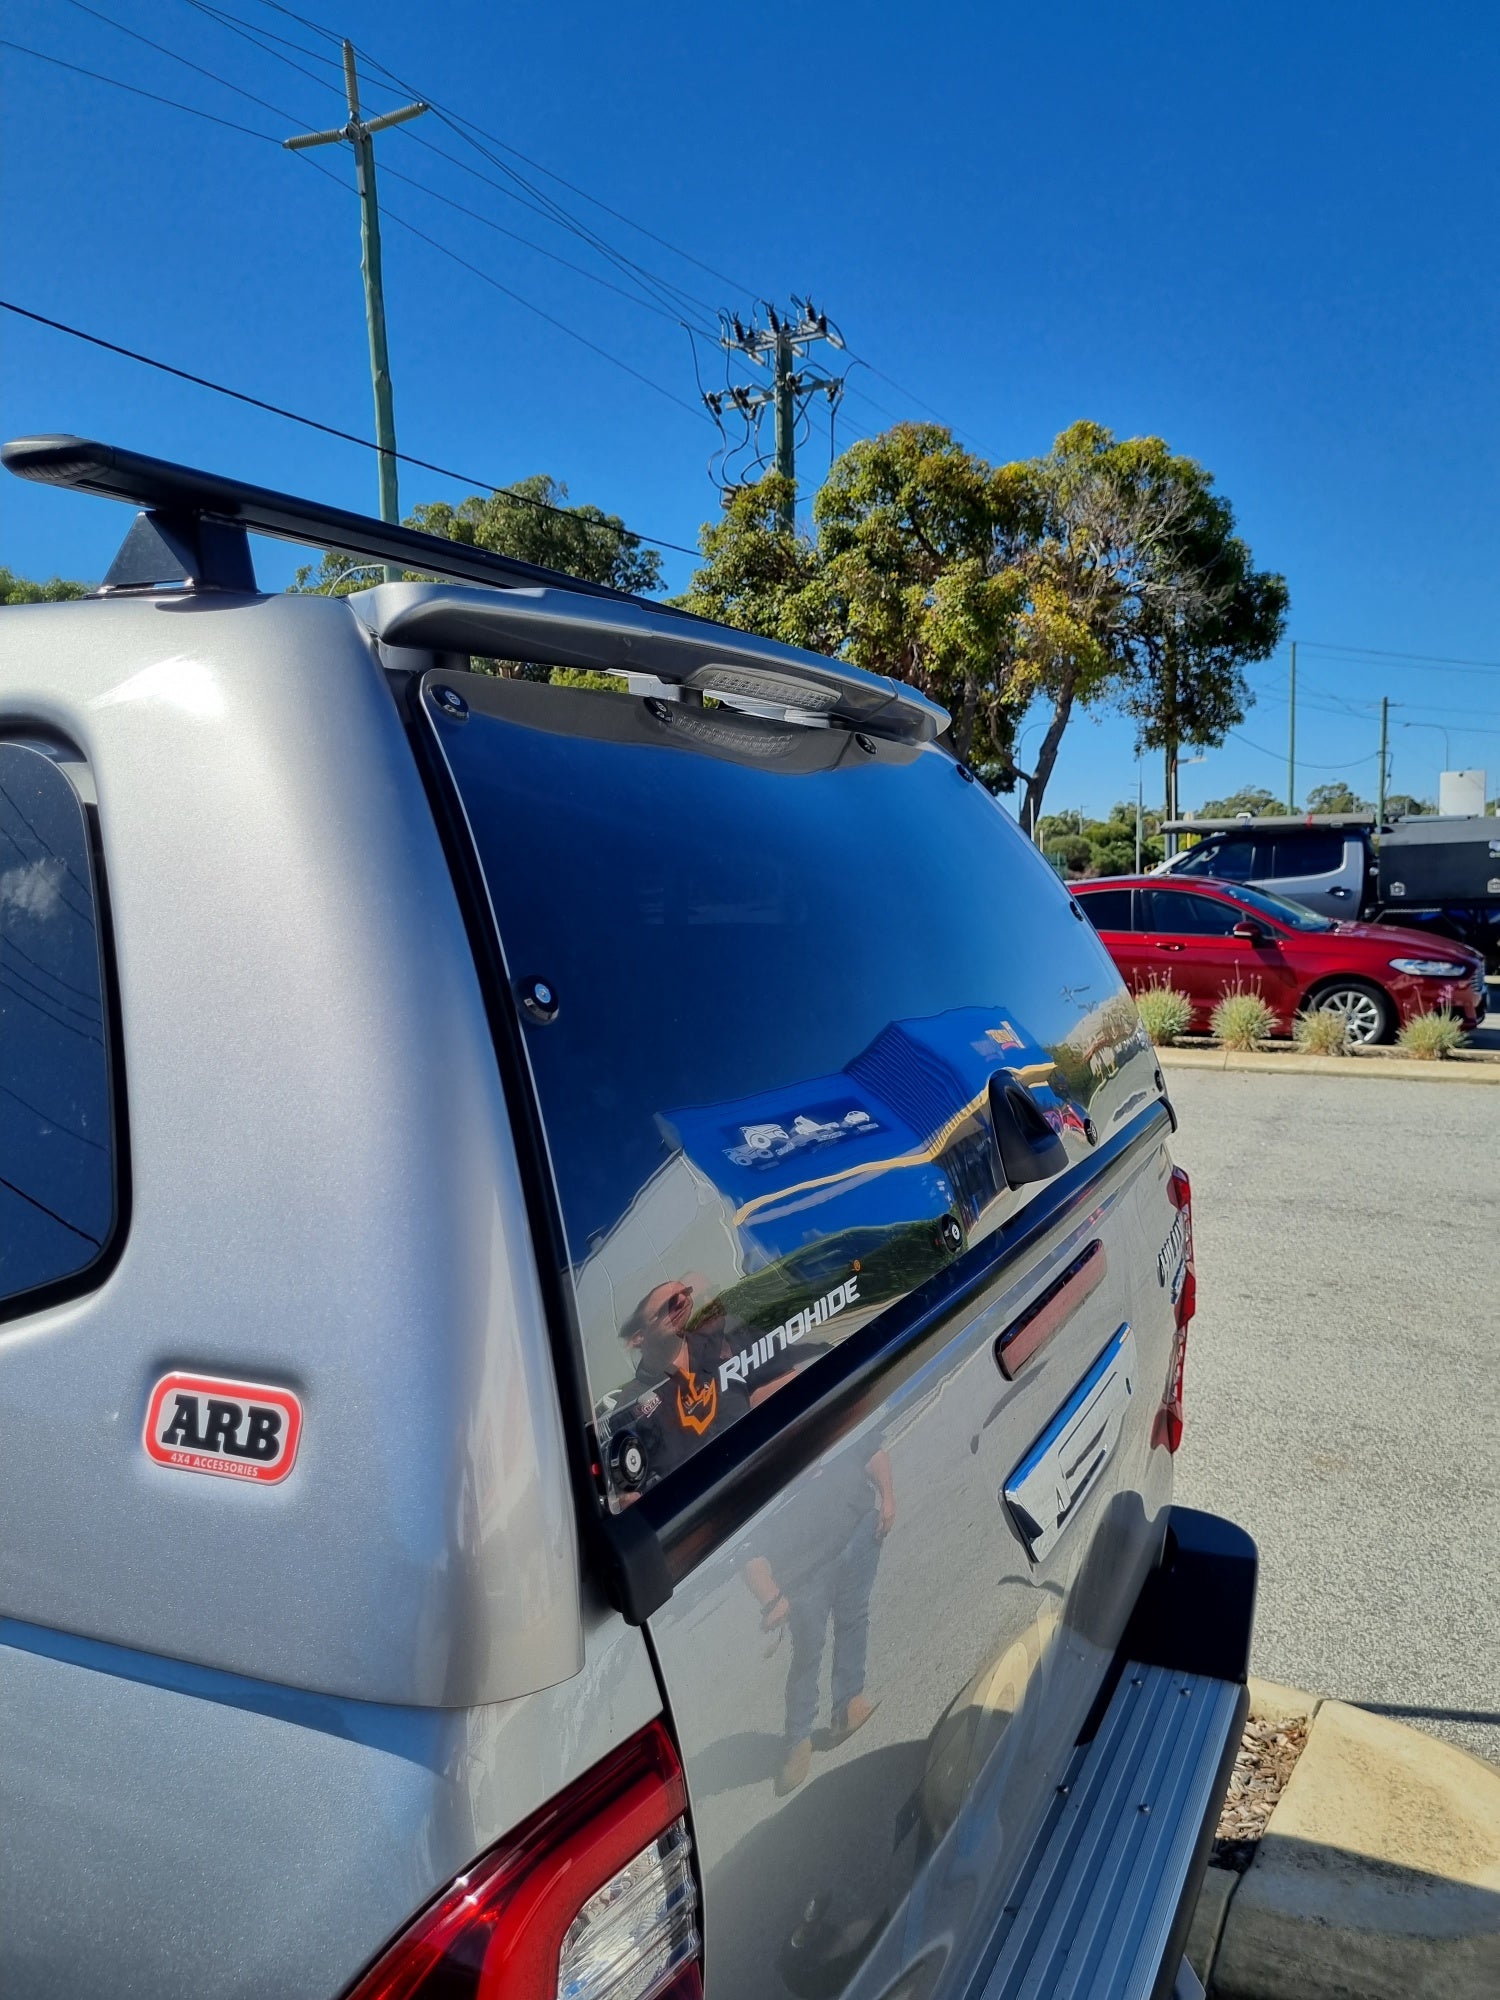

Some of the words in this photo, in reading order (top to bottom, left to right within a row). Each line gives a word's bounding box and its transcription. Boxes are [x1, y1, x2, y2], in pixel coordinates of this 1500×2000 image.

[718, 1275, 861, 1393] RHINOHIDE
[161, 1393, 282, 1462] ARB
[170, 1452, 191, 1465] 4X4
[193, 1454, 259, 1477] ACCESSORIES
